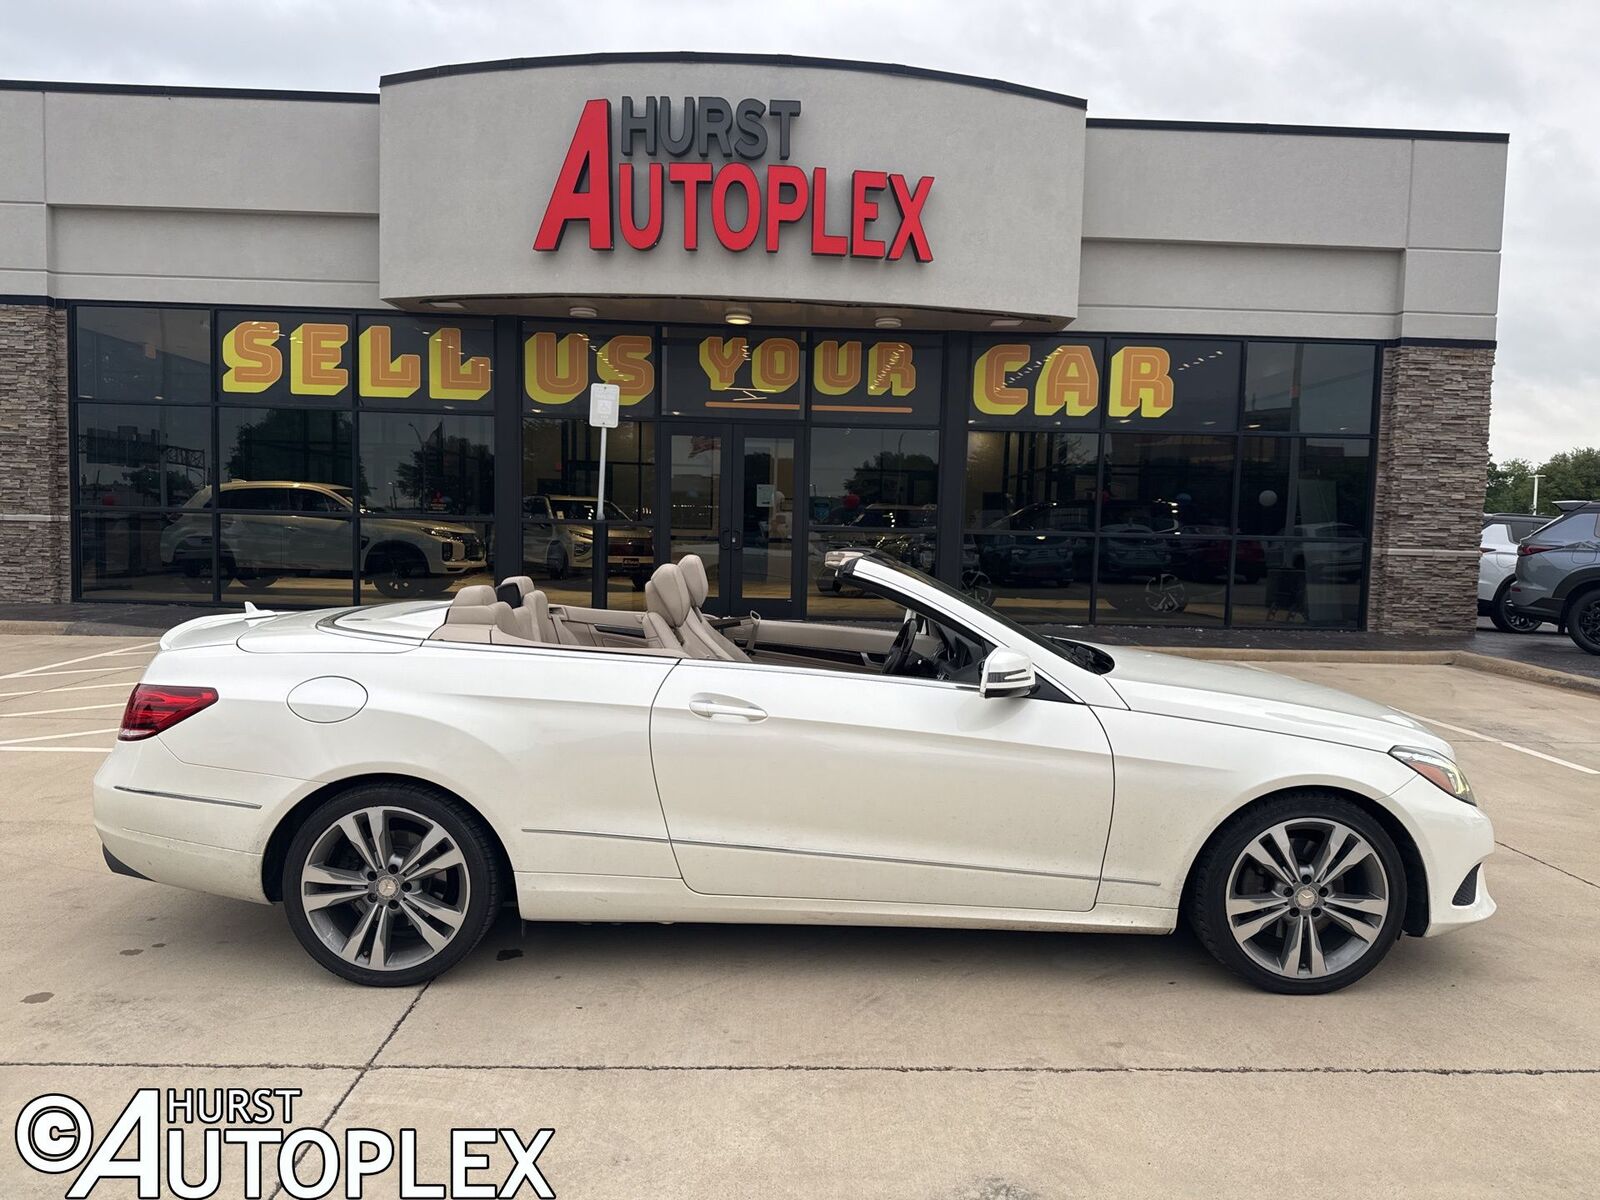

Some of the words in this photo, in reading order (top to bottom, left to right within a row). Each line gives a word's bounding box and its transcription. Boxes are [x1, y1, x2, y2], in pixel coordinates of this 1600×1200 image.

[621, 96, 801, 160] HURST
[532, 98, 935, 263] AUTOPLEX
[222, 320, 493, 401] SELL
[525, 332, 655, 406] US
[699, 336, 917, 396] YOUR
[973, 344, 1175, 418] CAR
